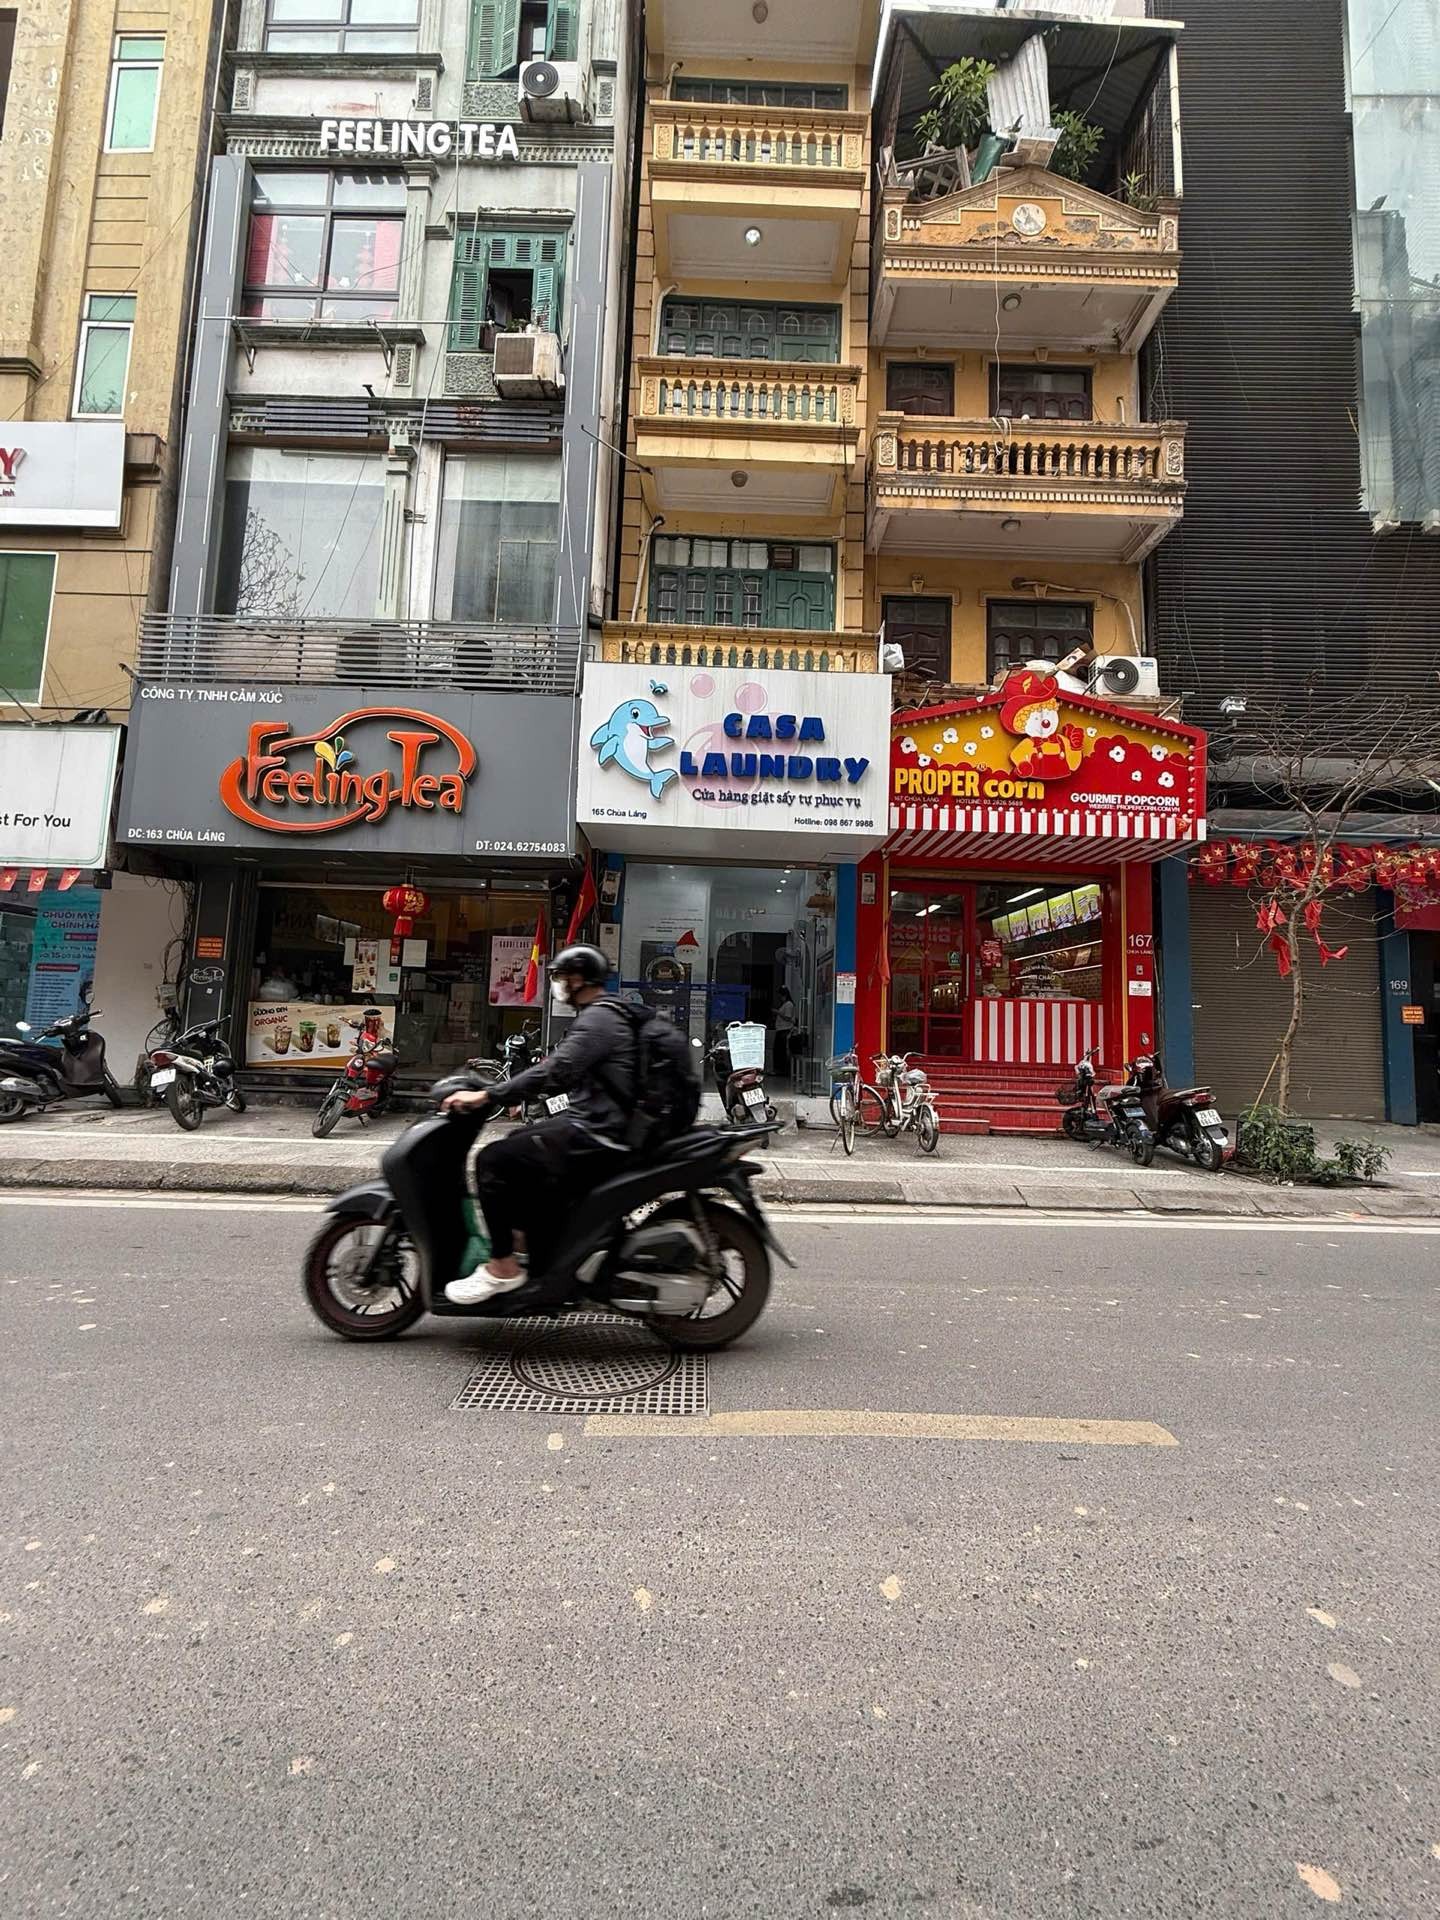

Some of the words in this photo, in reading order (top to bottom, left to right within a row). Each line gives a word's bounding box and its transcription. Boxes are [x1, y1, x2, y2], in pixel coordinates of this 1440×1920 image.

[321, 120, 452, 157] FEELING
[459, 123, 519, 161] TEA
[141, 686, 175, 699] CÔNG
[178, 689, 195, 700] TY
[197, 690, 228, 702] TNHH
[230, 687, 256, 703] CẢM
[258, 690, 283, 704] XÚC
[723, 712, 826, 742] CASA
[247, 721, 391, 823] Feeling
[386, 731, 466, 814] Tea
[680, 751, 870, 784] LAUNDRY
[894, 768, 980, 797] PROPER
[984, 779, 1045, 800] corn
[692, 788, 716, 801] Cửa
[719, 790, 749, 804] hàng
[750, 792, 774, 805] giặt
[777, 791, 796, 805] sấy
[799, 794, 812, 806] tự
[815, 794, 843, 808] phục
[846, 797, 862, 809] vụ
[1070, 793, 1122, 805] GOURMET
[1125, 795, 1180, 807] POPCORN
[592, 808, 605, 816] 165
[14, 814, 39, 827] For
[44, 814, 71, 828] You
[794, 817, 822, 826] Hotline:
[128, 828, 163, 839] ĐC:163
[166, 828, 193, 841] CHÙA
[197, 829, 225, 842] LÁNG
[1128, 934, 1153, 948] 167
[1390, 980, 1408, 990] 169
[254, 1015, 288, 1027] ORGANIC
